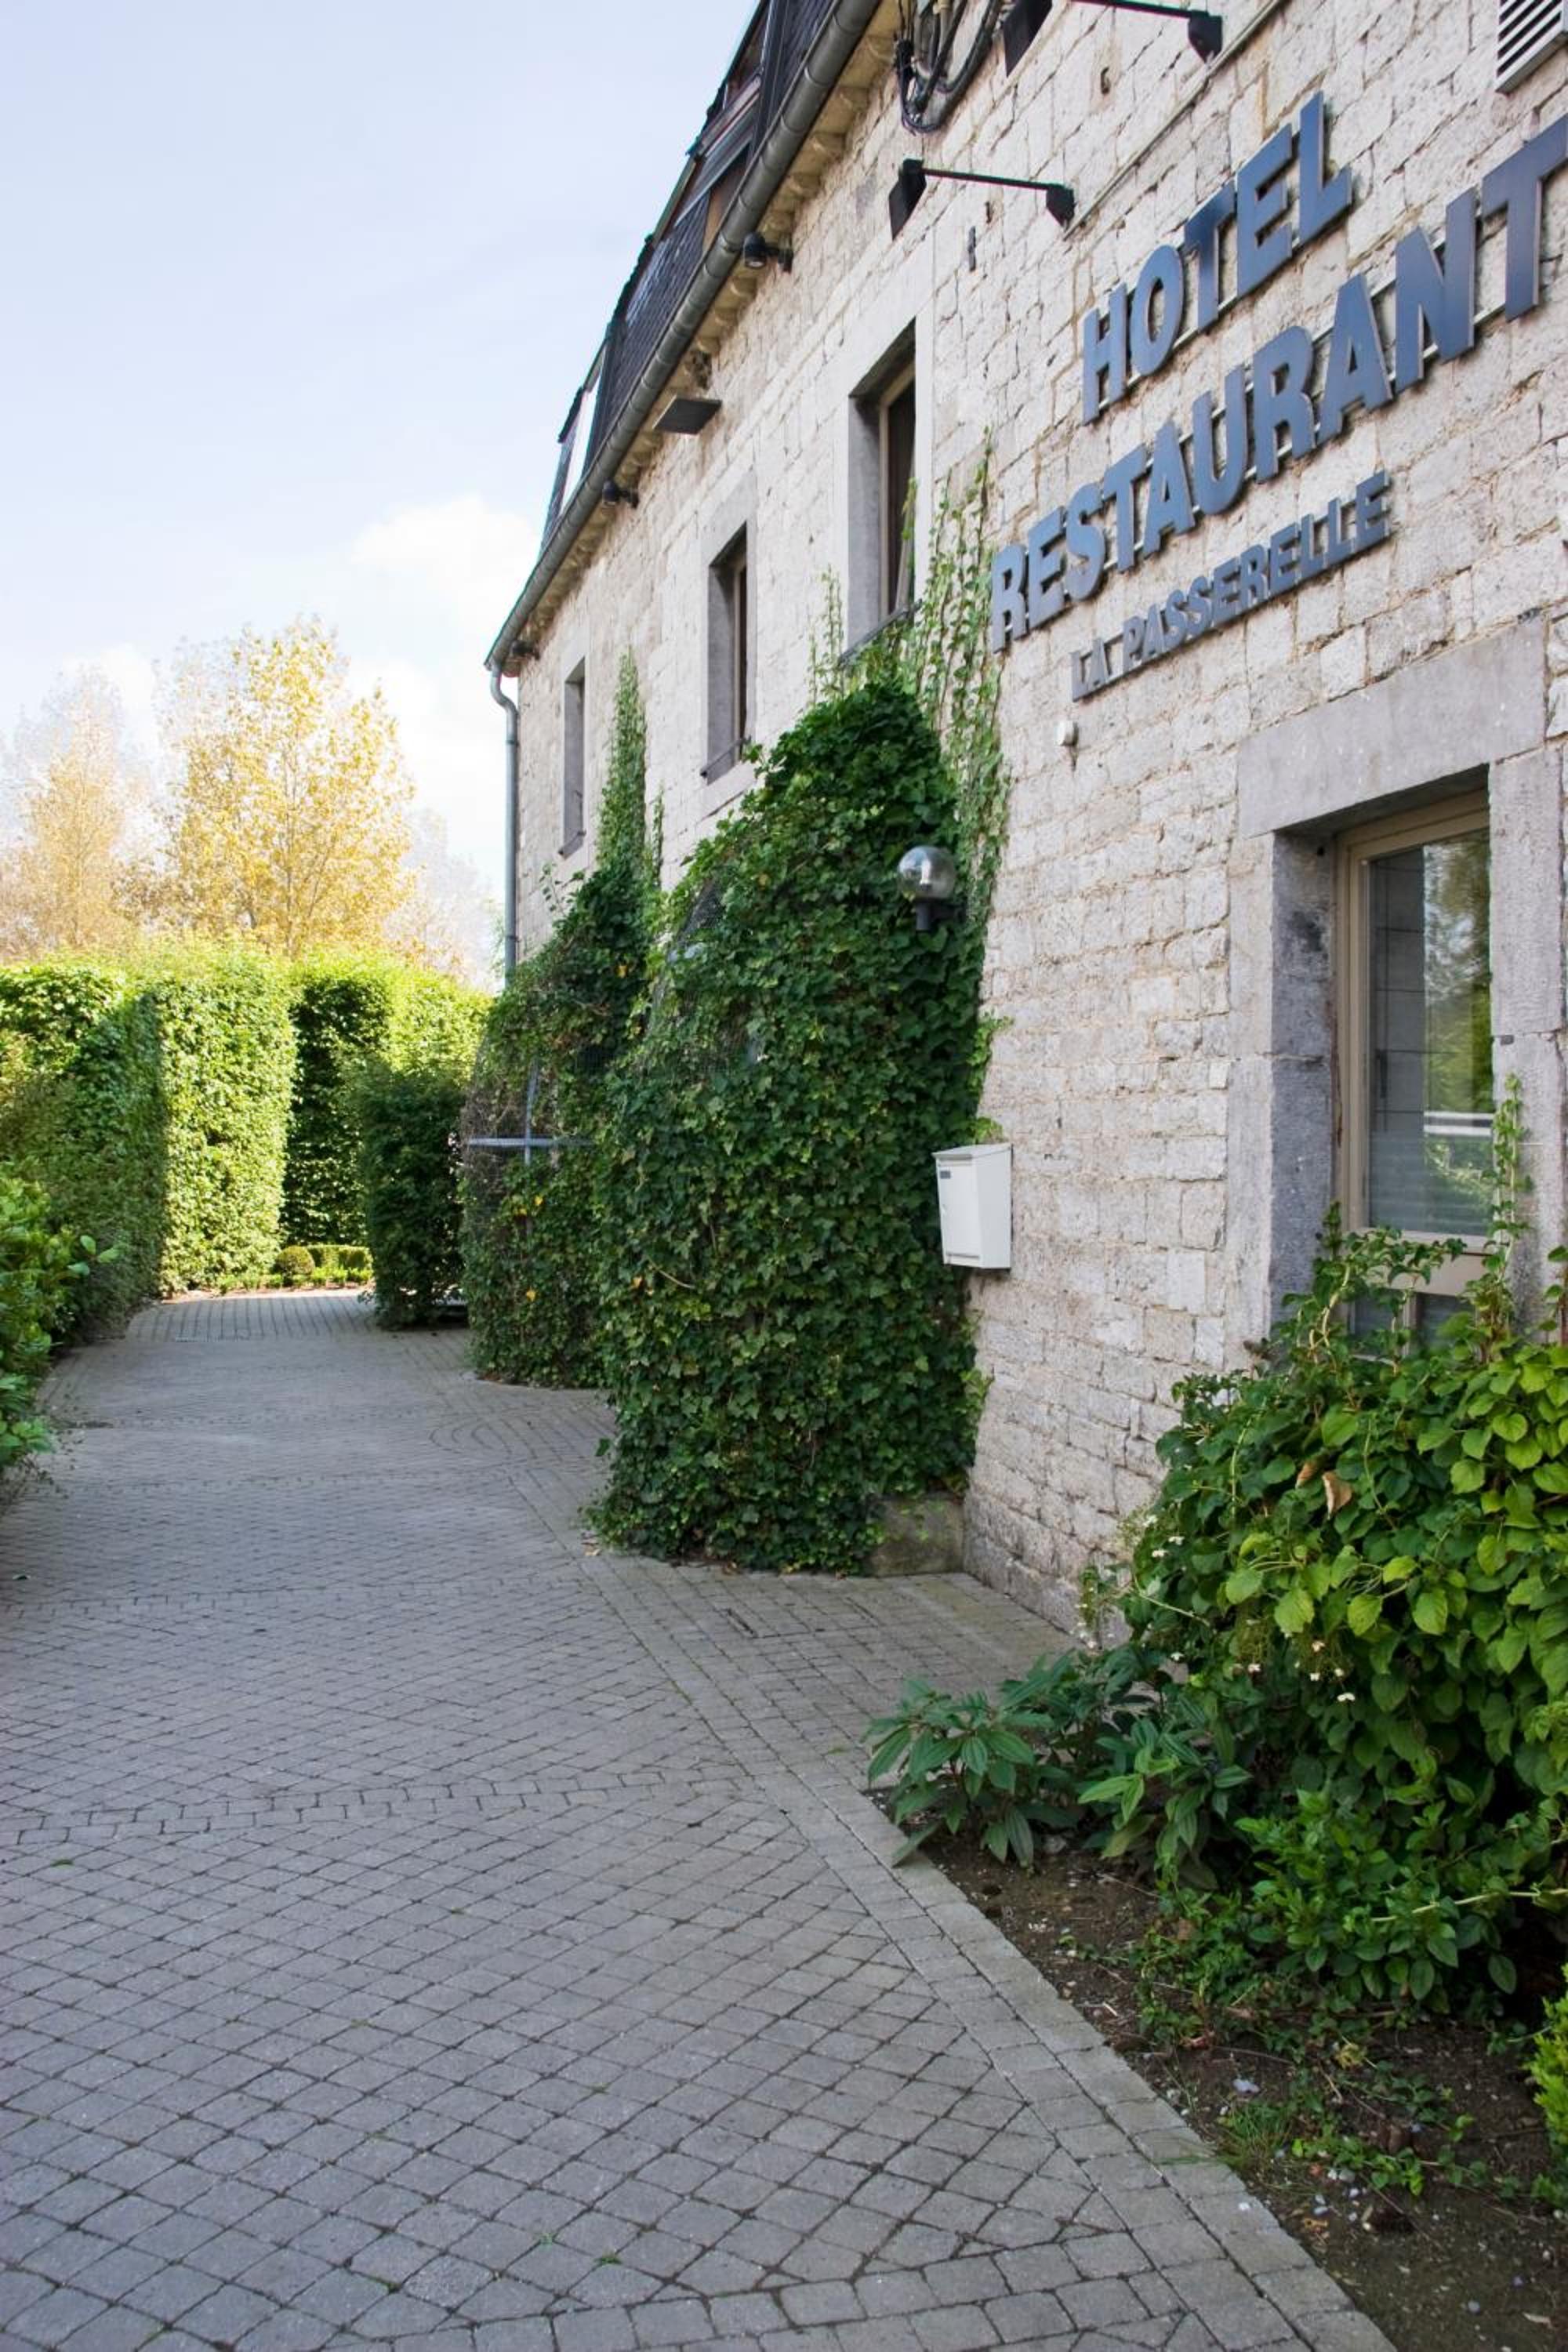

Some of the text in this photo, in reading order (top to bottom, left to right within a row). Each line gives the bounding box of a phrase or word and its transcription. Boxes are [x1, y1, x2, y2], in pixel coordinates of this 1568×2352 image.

[990, 113, 1568, 652] RESTAURANT
[1082, 91, 1352, 425] HOTEL
[1070, 470, 1392, 702] LA PASSERELLE
